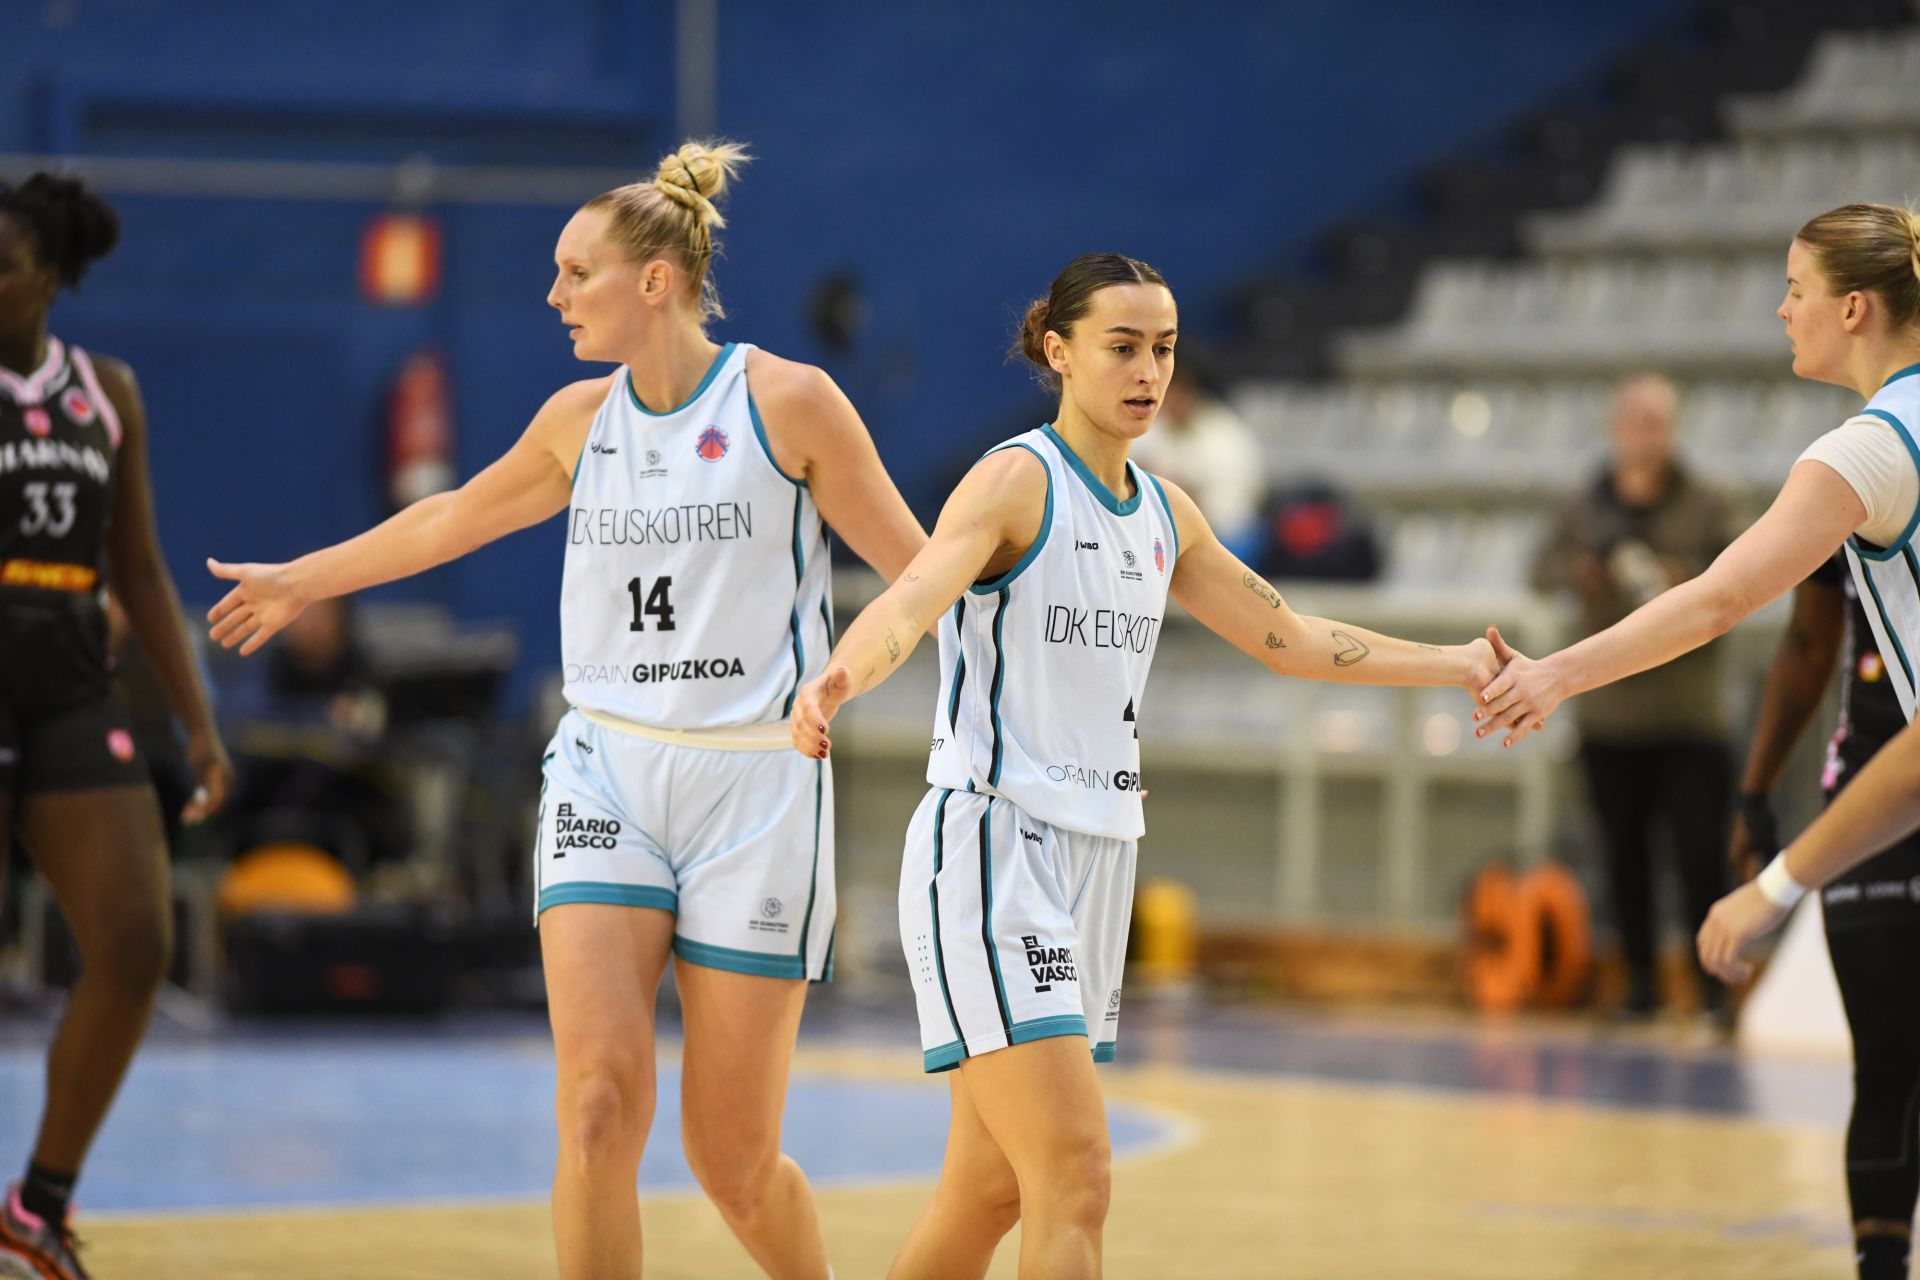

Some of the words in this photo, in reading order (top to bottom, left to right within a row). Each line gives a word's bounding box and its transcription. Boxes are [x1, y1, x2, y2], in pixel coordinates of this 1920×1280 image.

[20, 483, 77, 537] 33
[599, 502, 751, 544] EUSKOTREN
[628, 576, 675, 631] 14
[1045, 605, 1088, 646] IDK
[565, 663, 629, 683] ORAIN
[633, 657, 745, 682] GIPUZKOA
[1047, 765, 1108, 790] ORAIN
[557, 803, 576, 816] EL
[557, 819, 621, 835] DIARIO
[556, 835, 617, 849] VASCO
[1021, 935, 1044, 949] EL
[1031, 966, 1077, 983] VASCO
